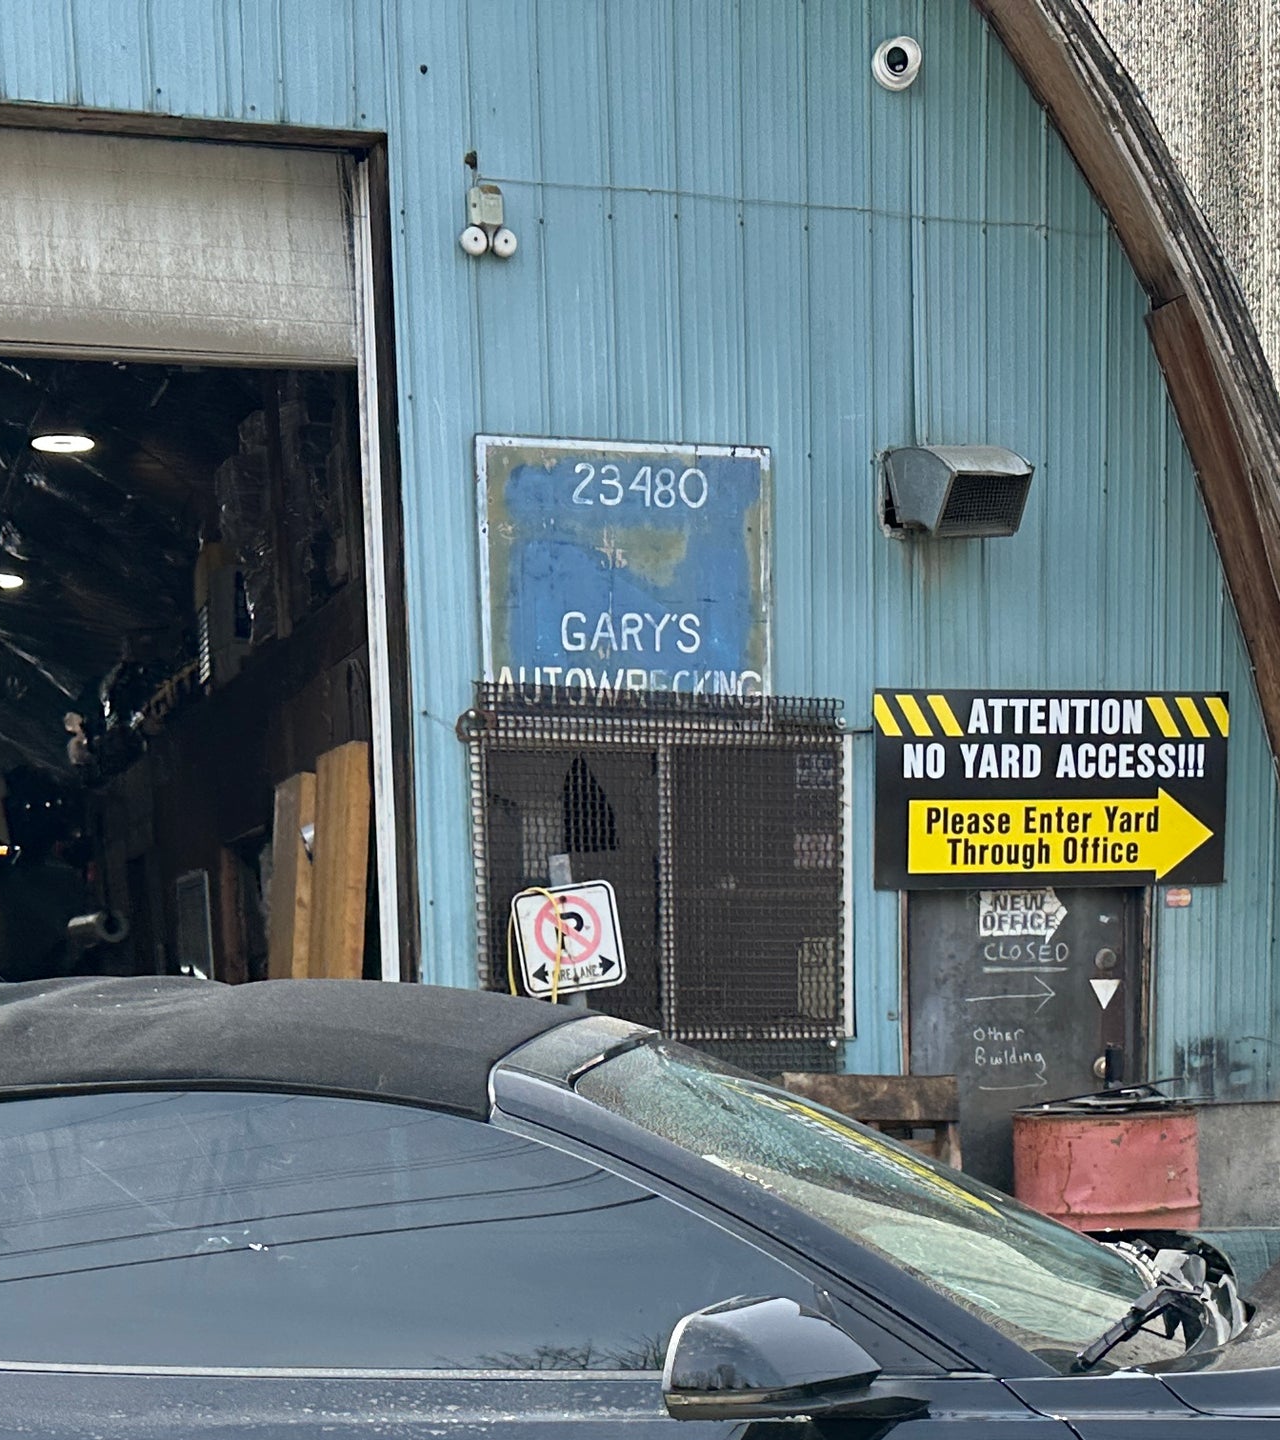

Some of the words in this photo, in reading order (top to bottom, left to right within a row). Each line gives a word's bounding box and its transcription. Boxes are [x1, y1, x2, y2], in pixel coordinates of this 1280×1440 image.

[572, 462, 709, 509] 23480
[560, 611, 701, 654] GARY'S
[967, 698, 1143, 735] ATTENTION
[903, 743, 945, 779] NO
[960, 743, 1042, 779] YARD
[1055, 743, 1206, 779] ACCESS!!!
[926, 807, 1011, 834] Please
[1024, 806, 1093, 834] Enter
[1104, 805, 1160, 833] Yard
[947, 838, 1051, 870] Through
[1064, 836, 1139, 864] Office
[993, 893, 1045, 911] NEW
[982, 911, 1056, 931] OFFICE
[984, 941, 1069, 962] CLOSED
[973, 1026, 1025, 1041] Other
[974, 1047, 1047, 1071] Building
